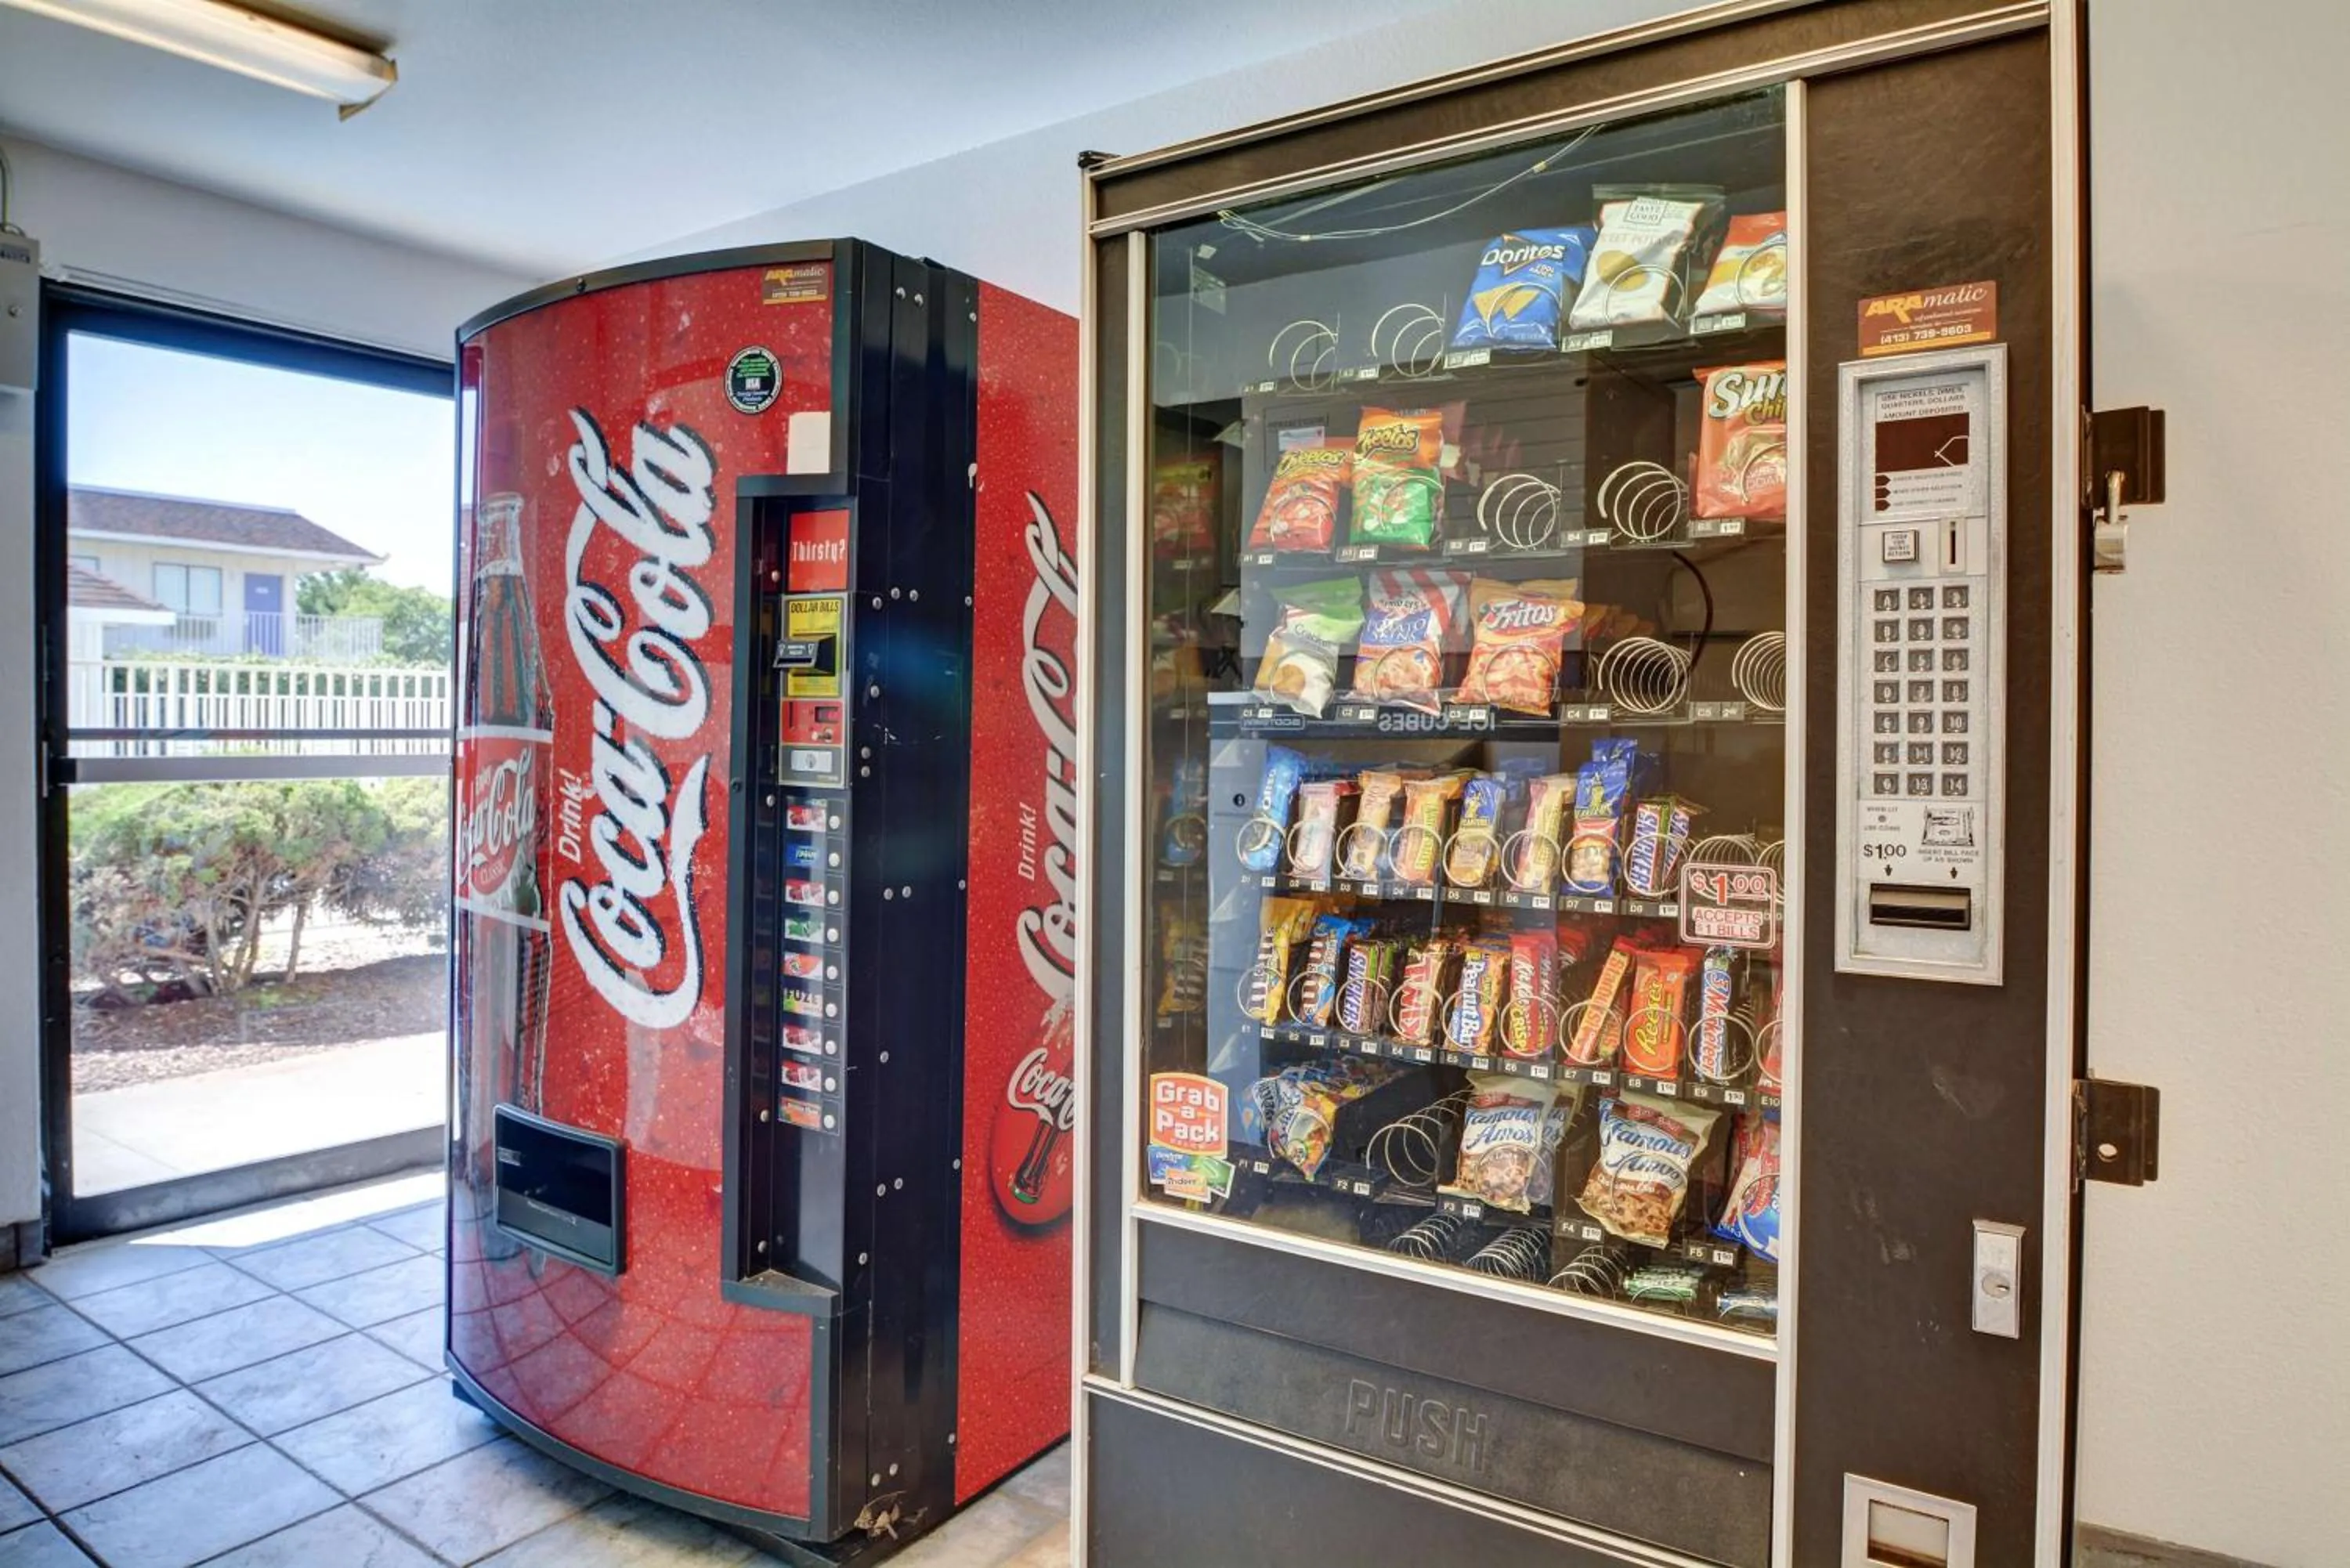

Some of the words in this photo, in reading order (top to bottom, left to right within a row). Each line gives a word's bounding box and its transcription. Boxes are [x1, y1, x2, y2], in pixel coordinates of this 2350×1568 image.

[1481, 244, 1566, 267] Doritos
[1881, 333, 1910, 345] (413)
[1744, 398, 1786, 425] Chi
[792, 538, 846, 562] Thirsty?
[1488, 600, 1557, 629] Fritos
[560, 408, 717, 1028] Coca-Cola
[1950, 716, 1962, 728] 10
[1950, 778, 1962, 790] 14
[559, 768, 583, 864] Drink!
[1019, 801, 1038, 882] Drink!
[1629, 811, 1659, 892] SNICKERS
[1864, 843, 1907, 860] $1.00
[1506, 894, 1518, 903] D6
[1567, 900, 1579, 909] D7
[1694, 909, 1762, 925] ACCEPTS
[1716, 923, 1759, 938] BILLS
[784, 988, 823, 1005] FUZE
[1343, 948, 1368, 1033] SNICKERS
[1461, 960, 1487, 1010] Peanut
[1399, 955, 1433, 1040] TWIX
[1510, 1005, 1528, 1051] CRISP
[1565, 1070, 1577, 1078] E7
[1629, 1078, 1642, 1088] E8
[1155, 1080, 1220, 1112] Grab
[1694, 1086, 1708, 1097] E9
[1762, 1097, 1781, 1107] E10
[1180, 1105, 1195, 1119] a
[1156, 1108, 1220, 1143] Pack
[1466, 1125, 1533, 1150] Amos
[1602, 1120, 1694, 1160] Famous
[1606, 1153, 1681, 1181] Amos
[1337, 1180, 1348, 1190] F2
[1444, 1203, 1455, 1212] F3
[1562, 1223, 1574, 1233] F4
[1345, 1377, 1488, 1474] PUSH
